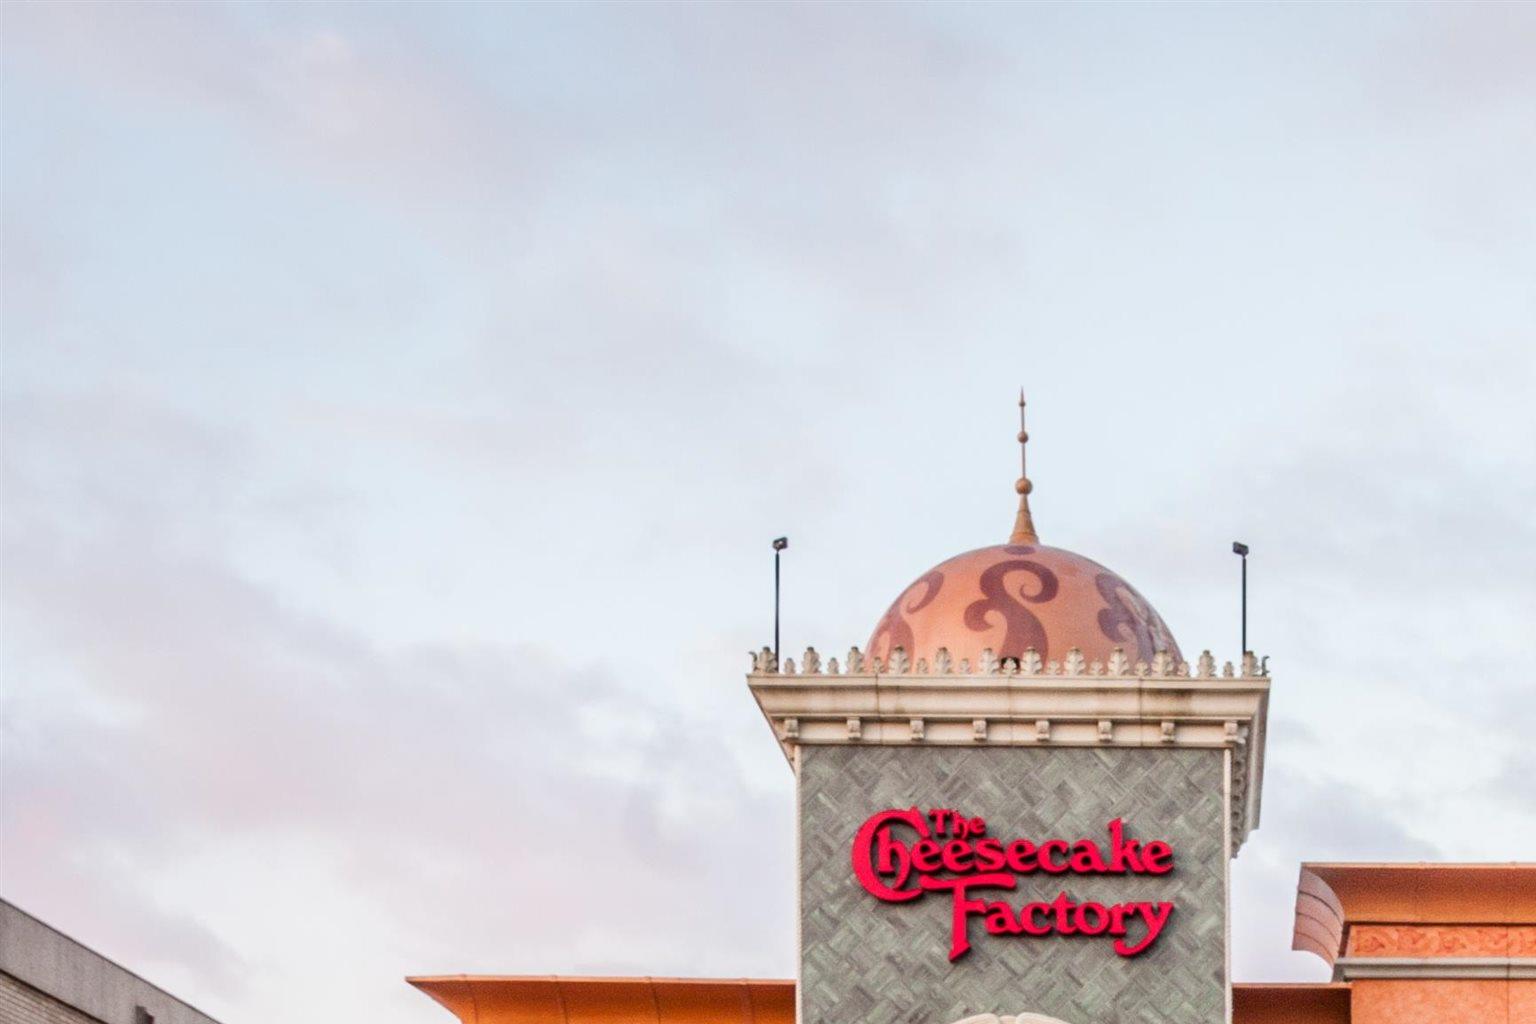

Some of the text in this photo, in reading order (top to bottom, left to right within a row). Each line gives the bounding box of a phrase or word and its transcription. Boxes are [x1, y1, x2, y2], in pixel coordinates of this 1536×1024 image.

[851, 805, 1176, 904] Cheesecake
[929, 808, 986, 839] The
[917, 872, 1176, 963] Factory
